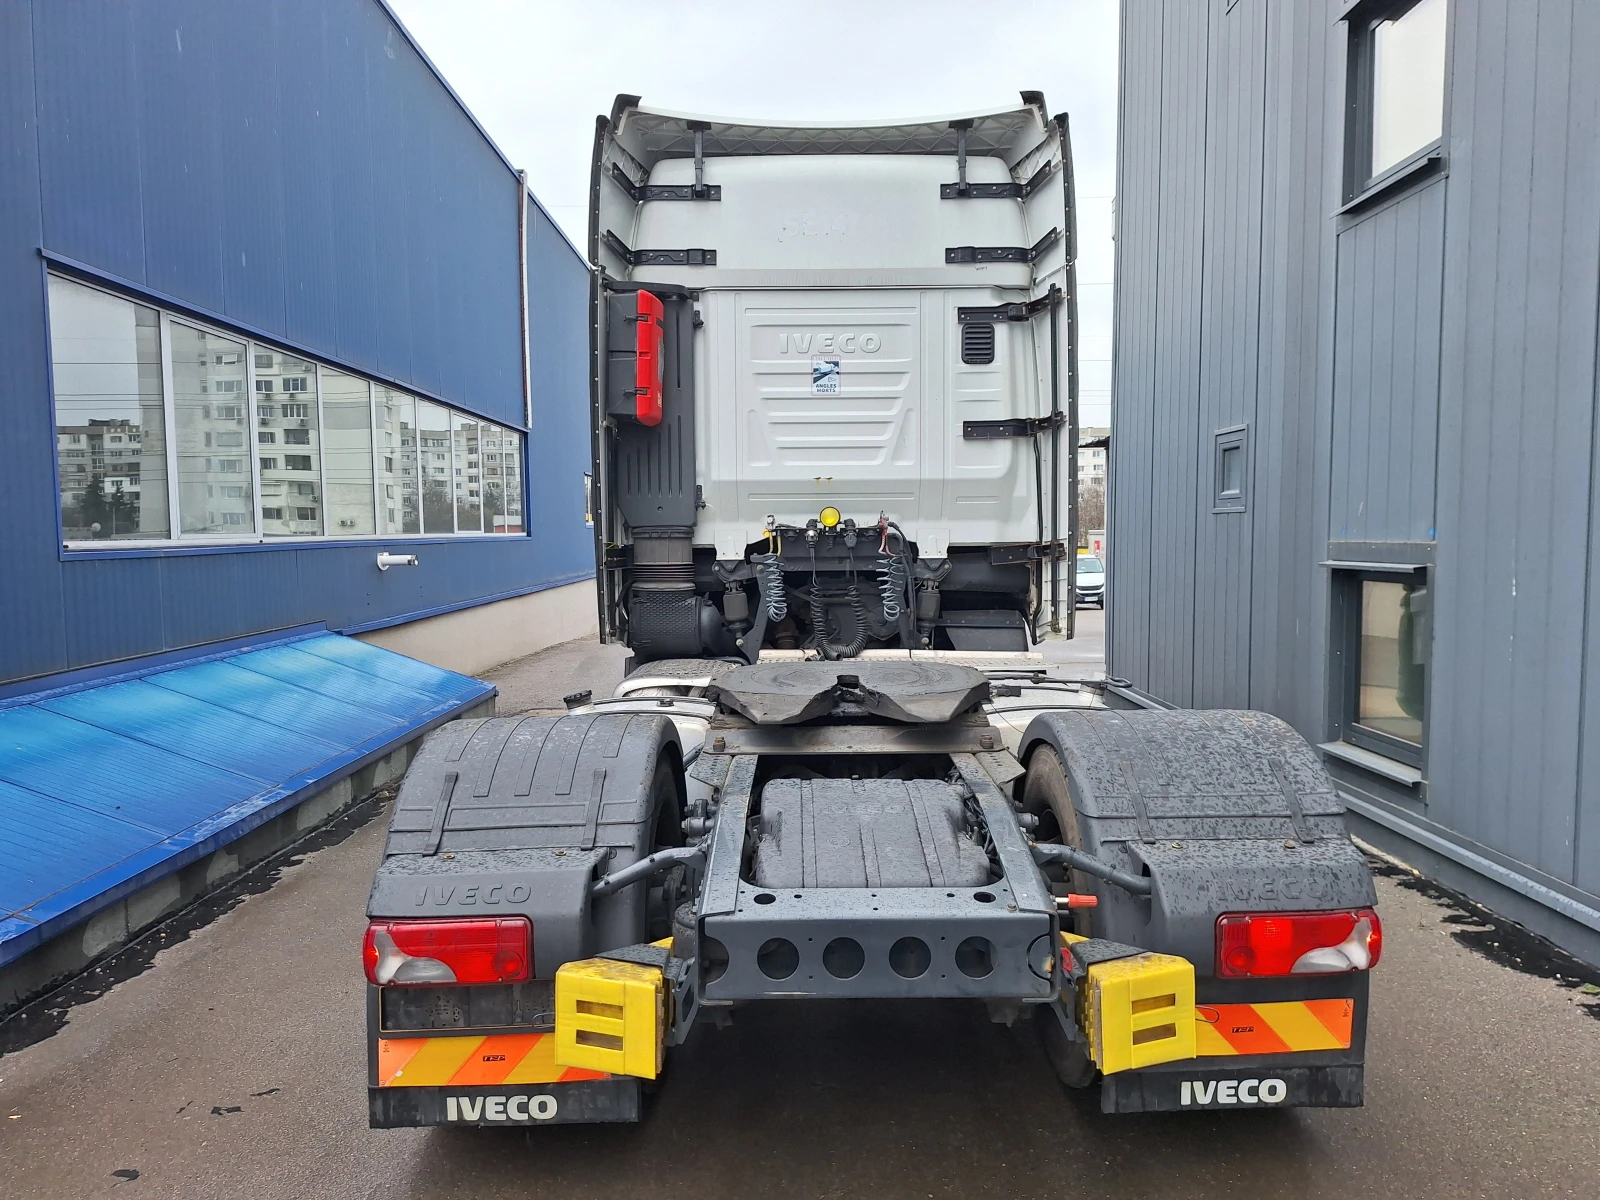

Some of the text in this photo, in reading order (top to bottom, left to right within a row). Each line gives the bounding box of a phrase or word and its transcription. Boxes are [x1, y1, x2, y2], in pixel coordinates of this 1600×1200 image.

[780, 333, 881, 354] IVECO
[414, 882, 532, 906] IVECO
[1217, 877, 1331, 900] IVECO
[1180, 1078, 1287, 1106] IVECO
[446, 1094, 558, 1121] IVECO
